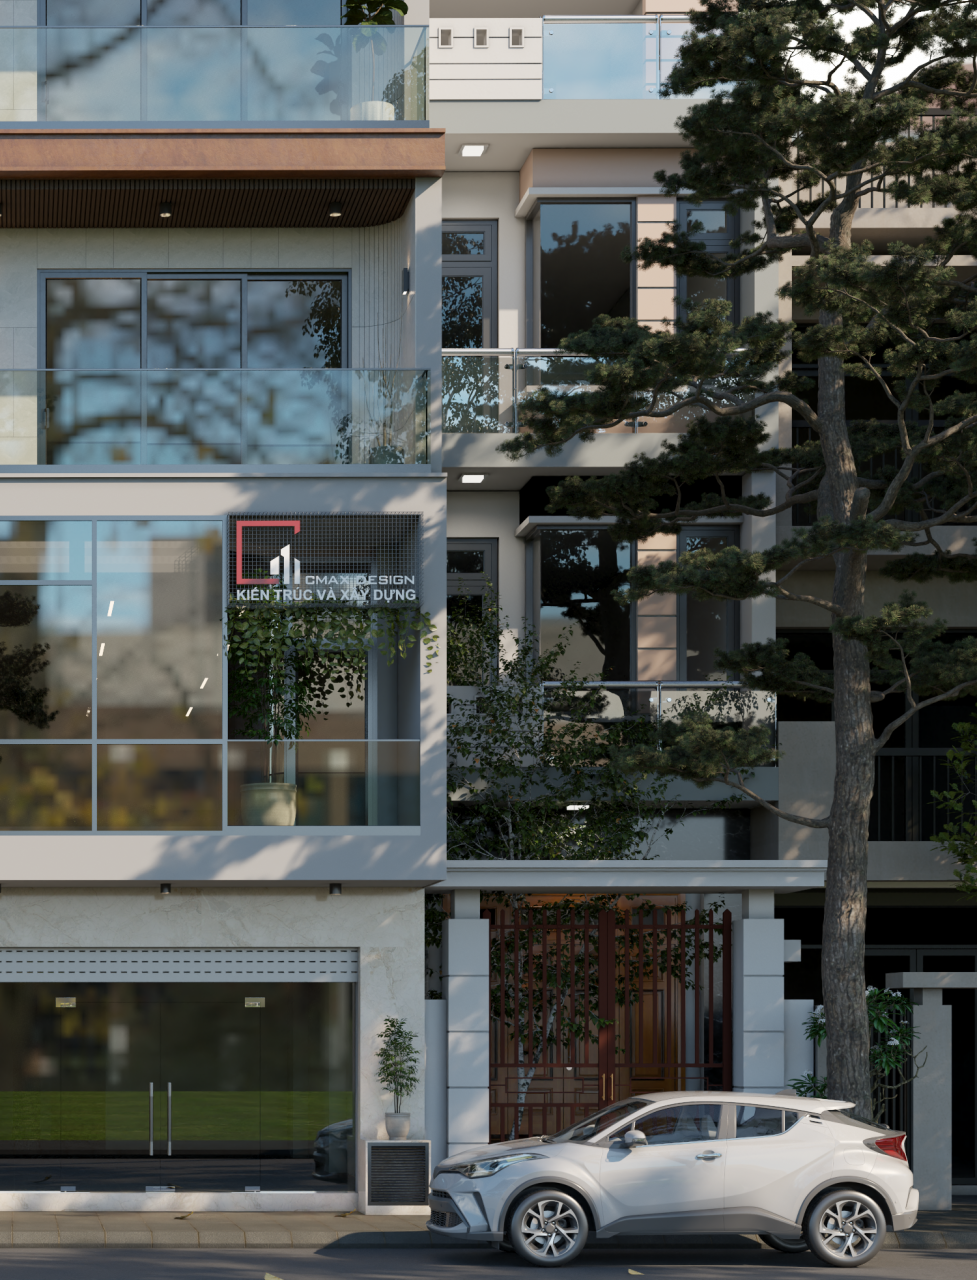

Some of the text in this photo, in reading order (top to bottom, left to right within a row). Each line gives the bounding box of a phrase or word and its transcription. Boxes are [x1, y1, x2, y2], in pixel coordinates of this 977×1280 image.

[305, 575, 415, 585] CMAX DESIGN
[236, 586, 416, 604] KIẾN TRÚC VÀ XÂY DỰNG
